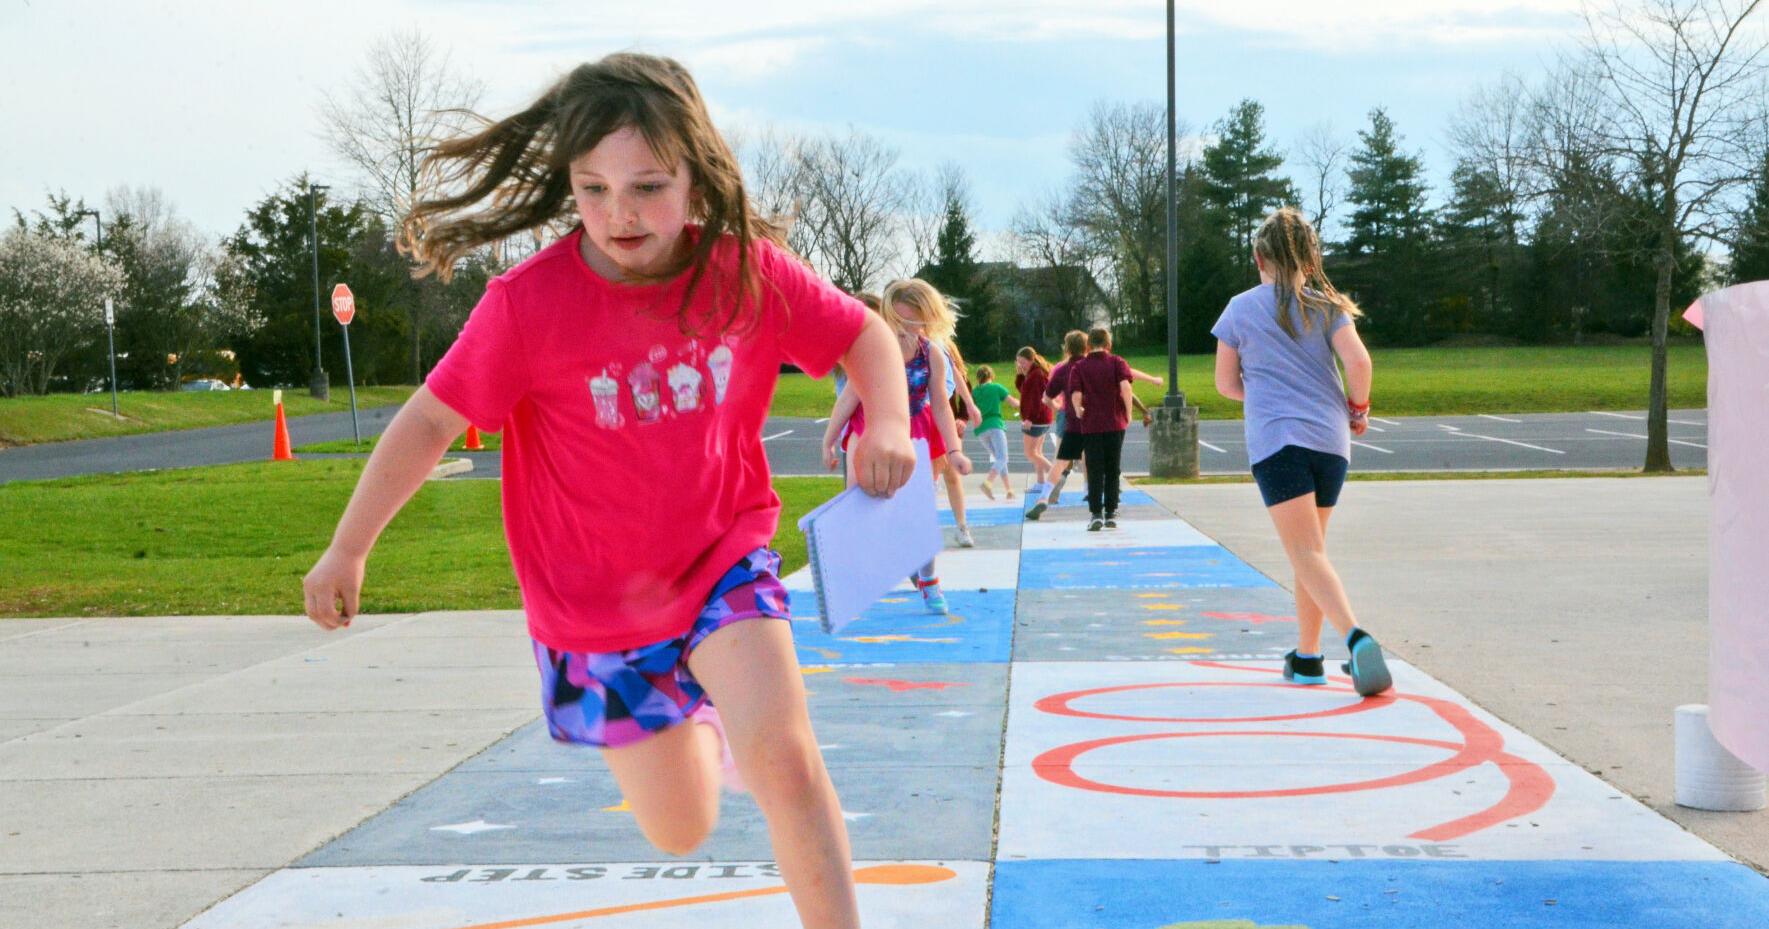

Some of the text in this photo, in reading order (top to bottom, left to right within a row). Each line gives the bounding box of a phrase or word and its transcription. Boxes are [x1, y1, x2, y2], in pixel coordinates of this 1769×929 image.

[333, 296, 353, 311] STOP
[1182, 844, 1469, 858] TIPTOE
[420, 863, 784, 883] SIDE STEP
